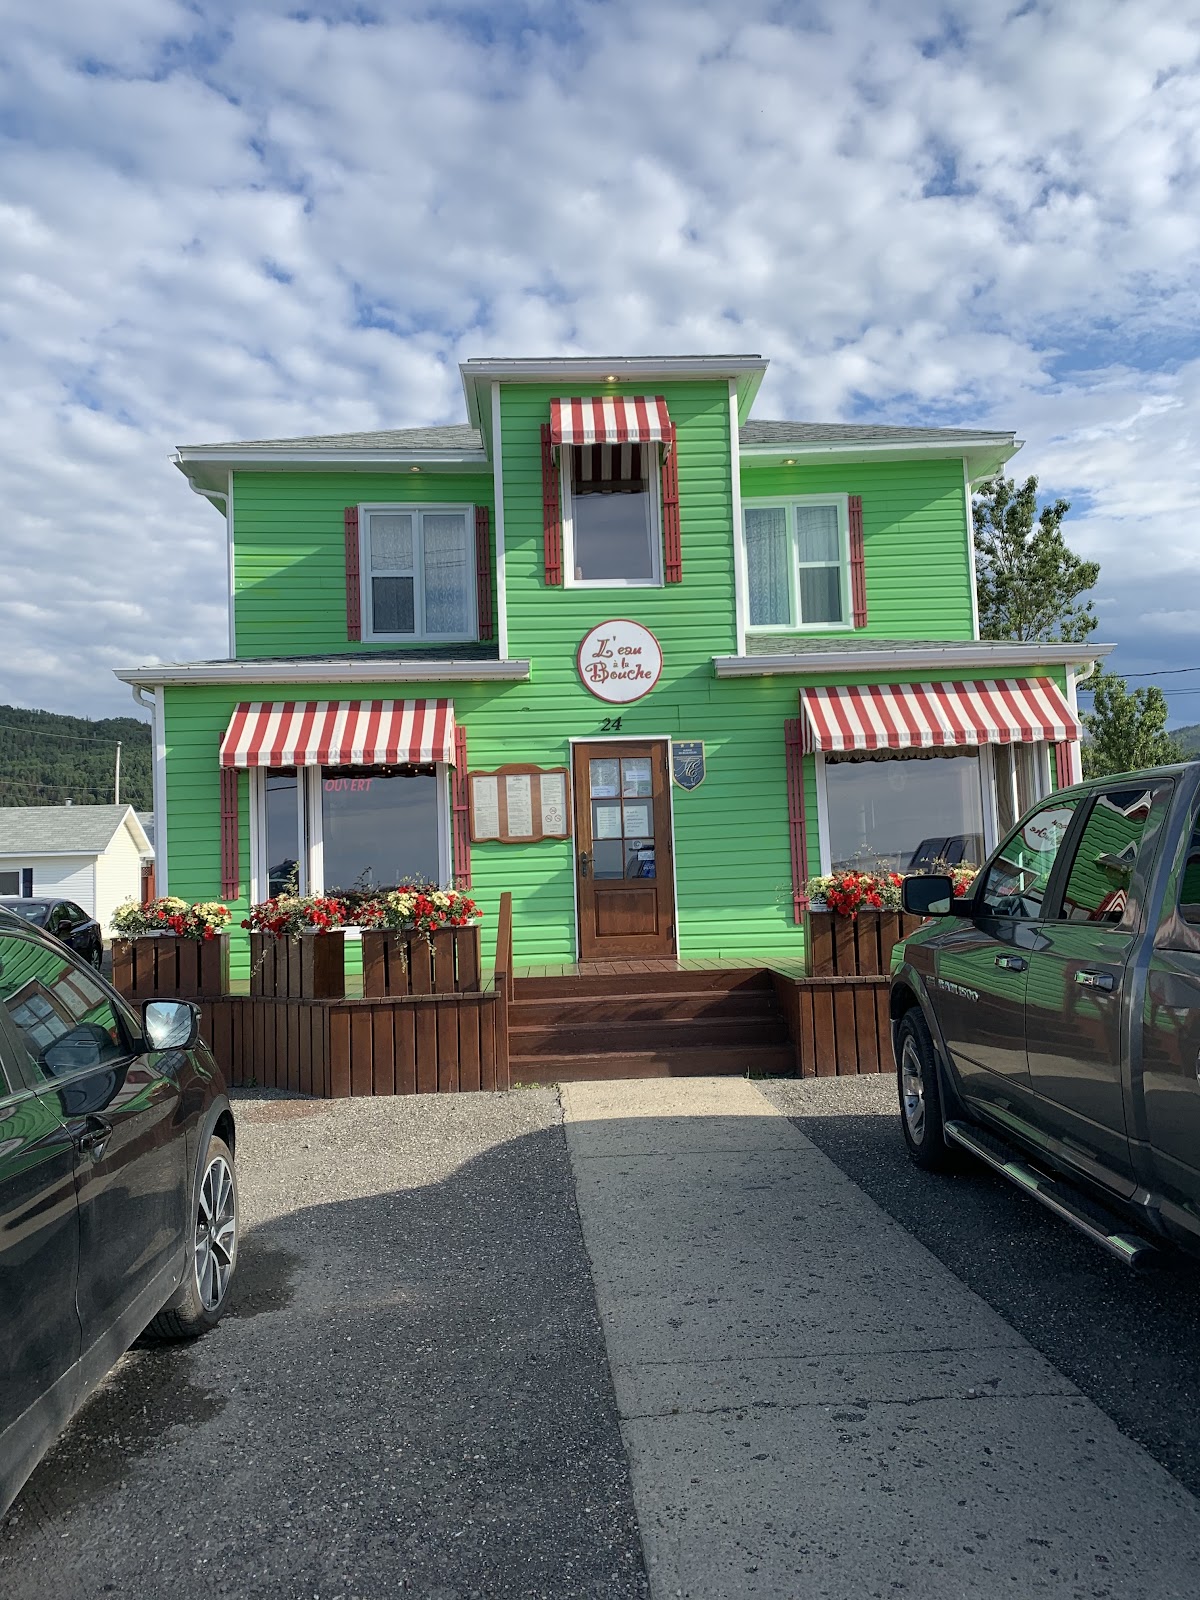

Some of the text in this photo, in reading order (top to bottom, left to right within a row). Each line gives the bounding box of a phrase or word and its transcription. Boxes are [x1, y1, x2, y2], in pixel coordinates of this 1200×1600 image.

[592, 635, 642, 659] L'eau
[613, 657, 630, 669] à la
[584, 660, 652, 684] Bouche
[600, 716, 623, 732] 24
[324, 778, 373, 792] OUVERT
